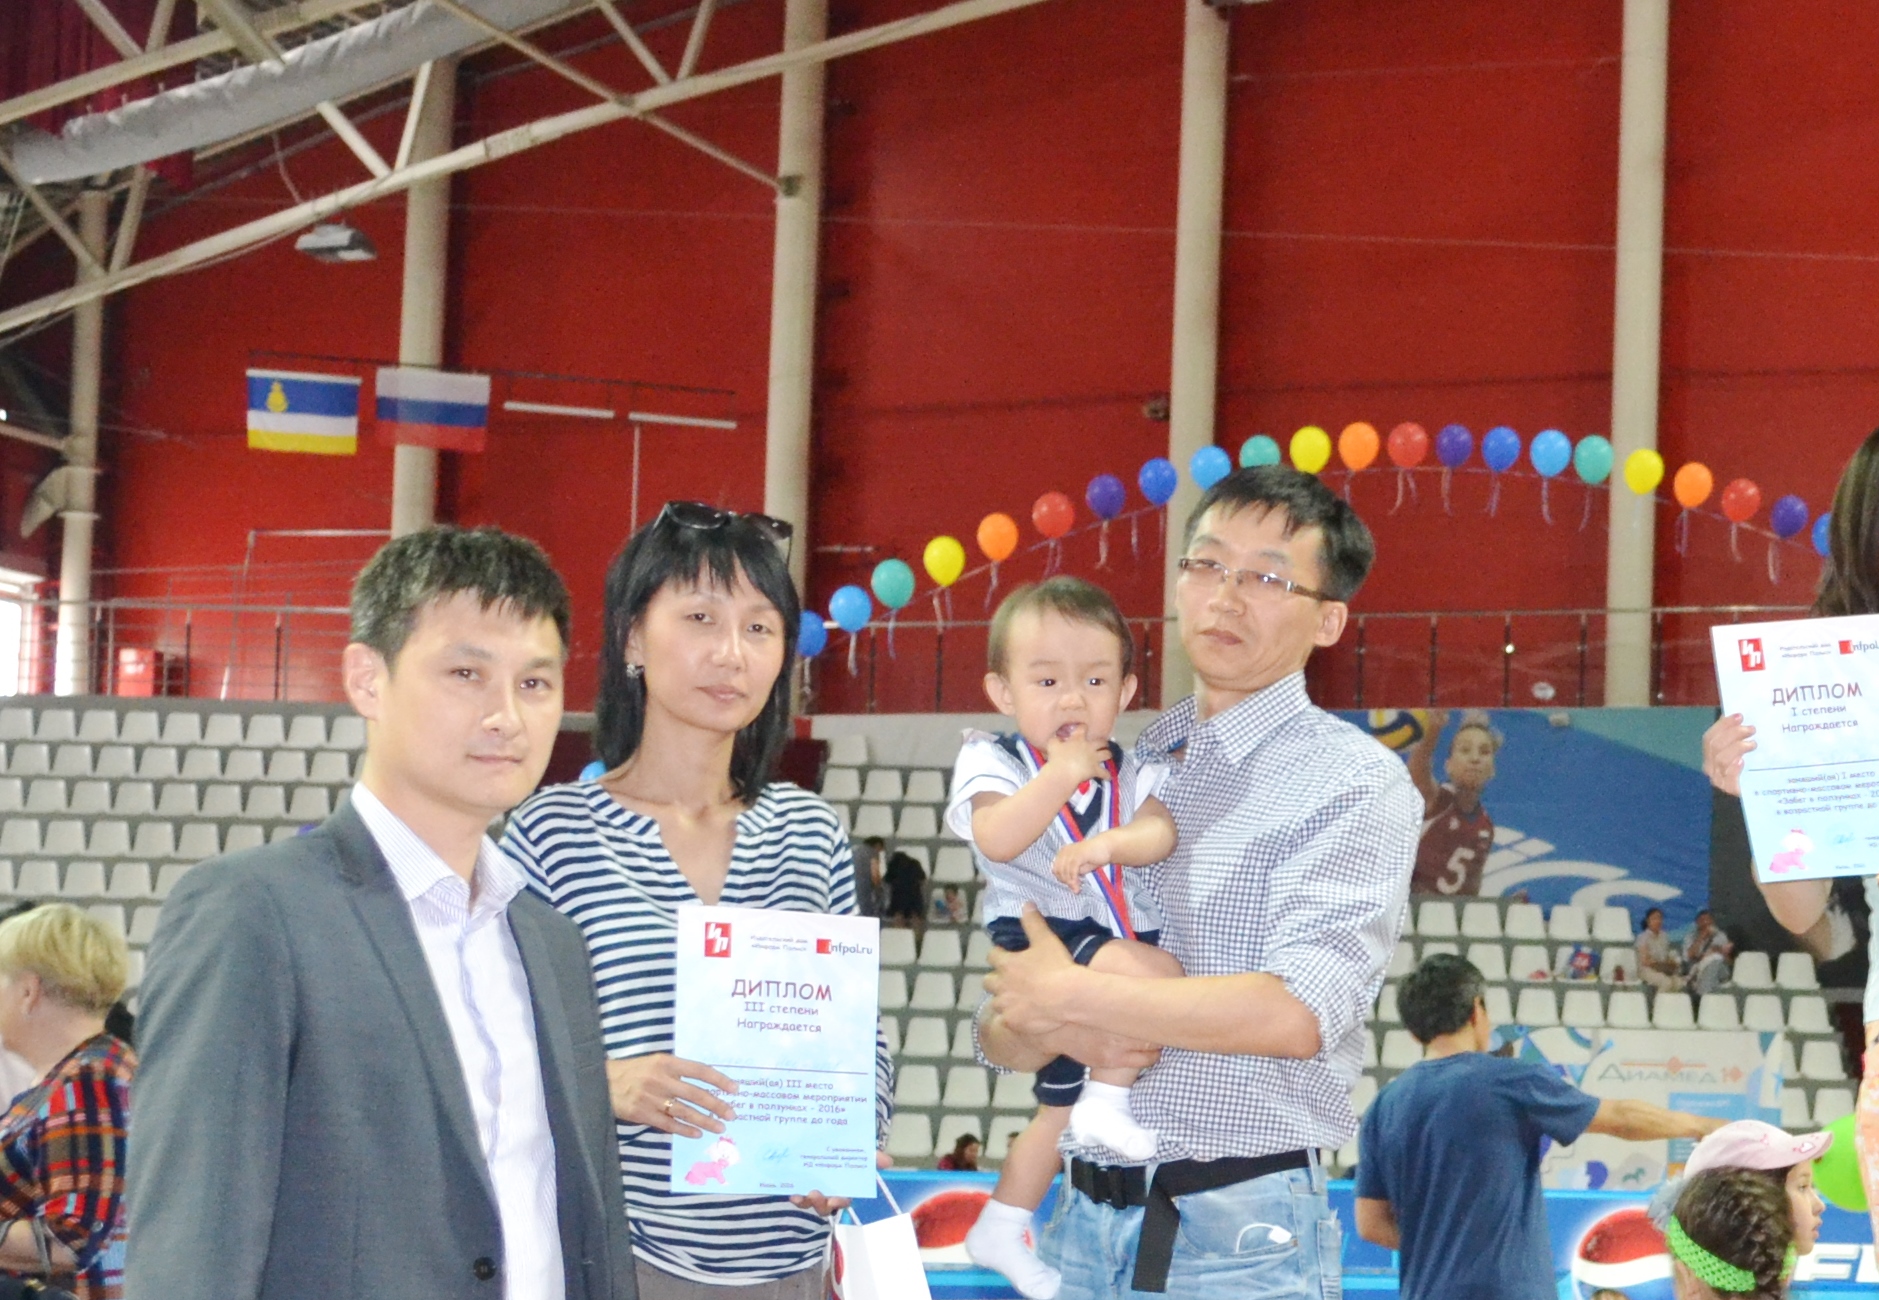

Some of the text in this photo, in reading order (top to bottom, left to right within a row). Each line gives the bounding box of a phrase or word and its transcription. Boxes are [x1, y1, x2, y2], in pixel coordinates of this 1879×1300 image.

[1771, 682, 1863, 706] ДИПЛОМ
[1801, 704, 1847, 717] степени
[1782, 720, 1858, 734] Награждается
[1436, 847, 1476, 895] 5
[828, 940, 873, 956] infpol.ru
[731, 978, 833, 1002] ДИПЛОМ
[744, 1001, 820, 1017] III степени
[736, 1017, 822, 1033] Награждается
[805, 1081, 834, 1090] место
[803, 1093, 868, 1105] мероприятии
[757, 1102, 808, 1114] ползунках
[774, 1114, 808, 1125] группе
[811, 1116, 824, 1126] до
[825, 1116, 848, 1126] года
